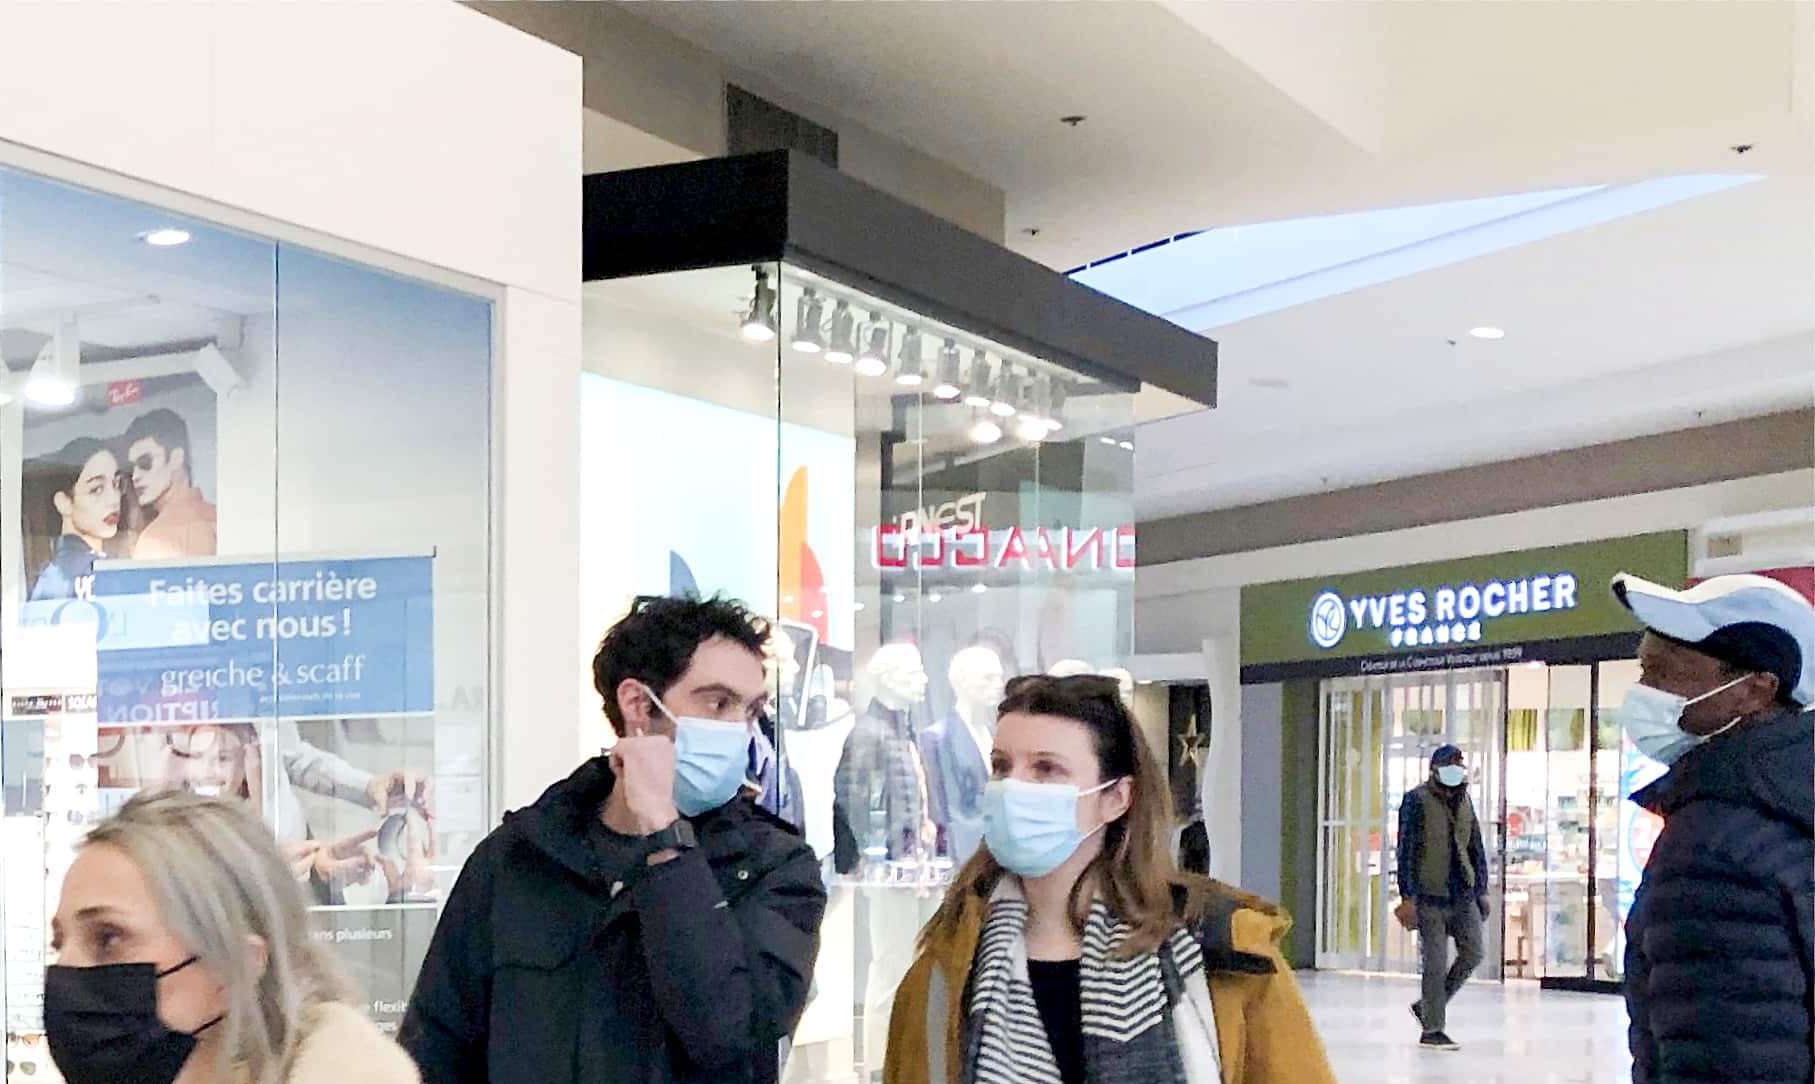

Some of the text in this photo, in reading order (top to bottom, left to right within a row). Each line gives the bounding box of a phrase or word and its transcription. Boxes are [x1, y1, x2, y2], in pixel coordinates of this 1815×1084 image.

[149, 570, 377, 607] Faites carrière
[1349, 573, 1578, 629] YVES ROCHER
[173, 615, 247, 642] avec
[1390, 621, 1481, 647] FRANCE
[296, 654, 366, 684] scaff
